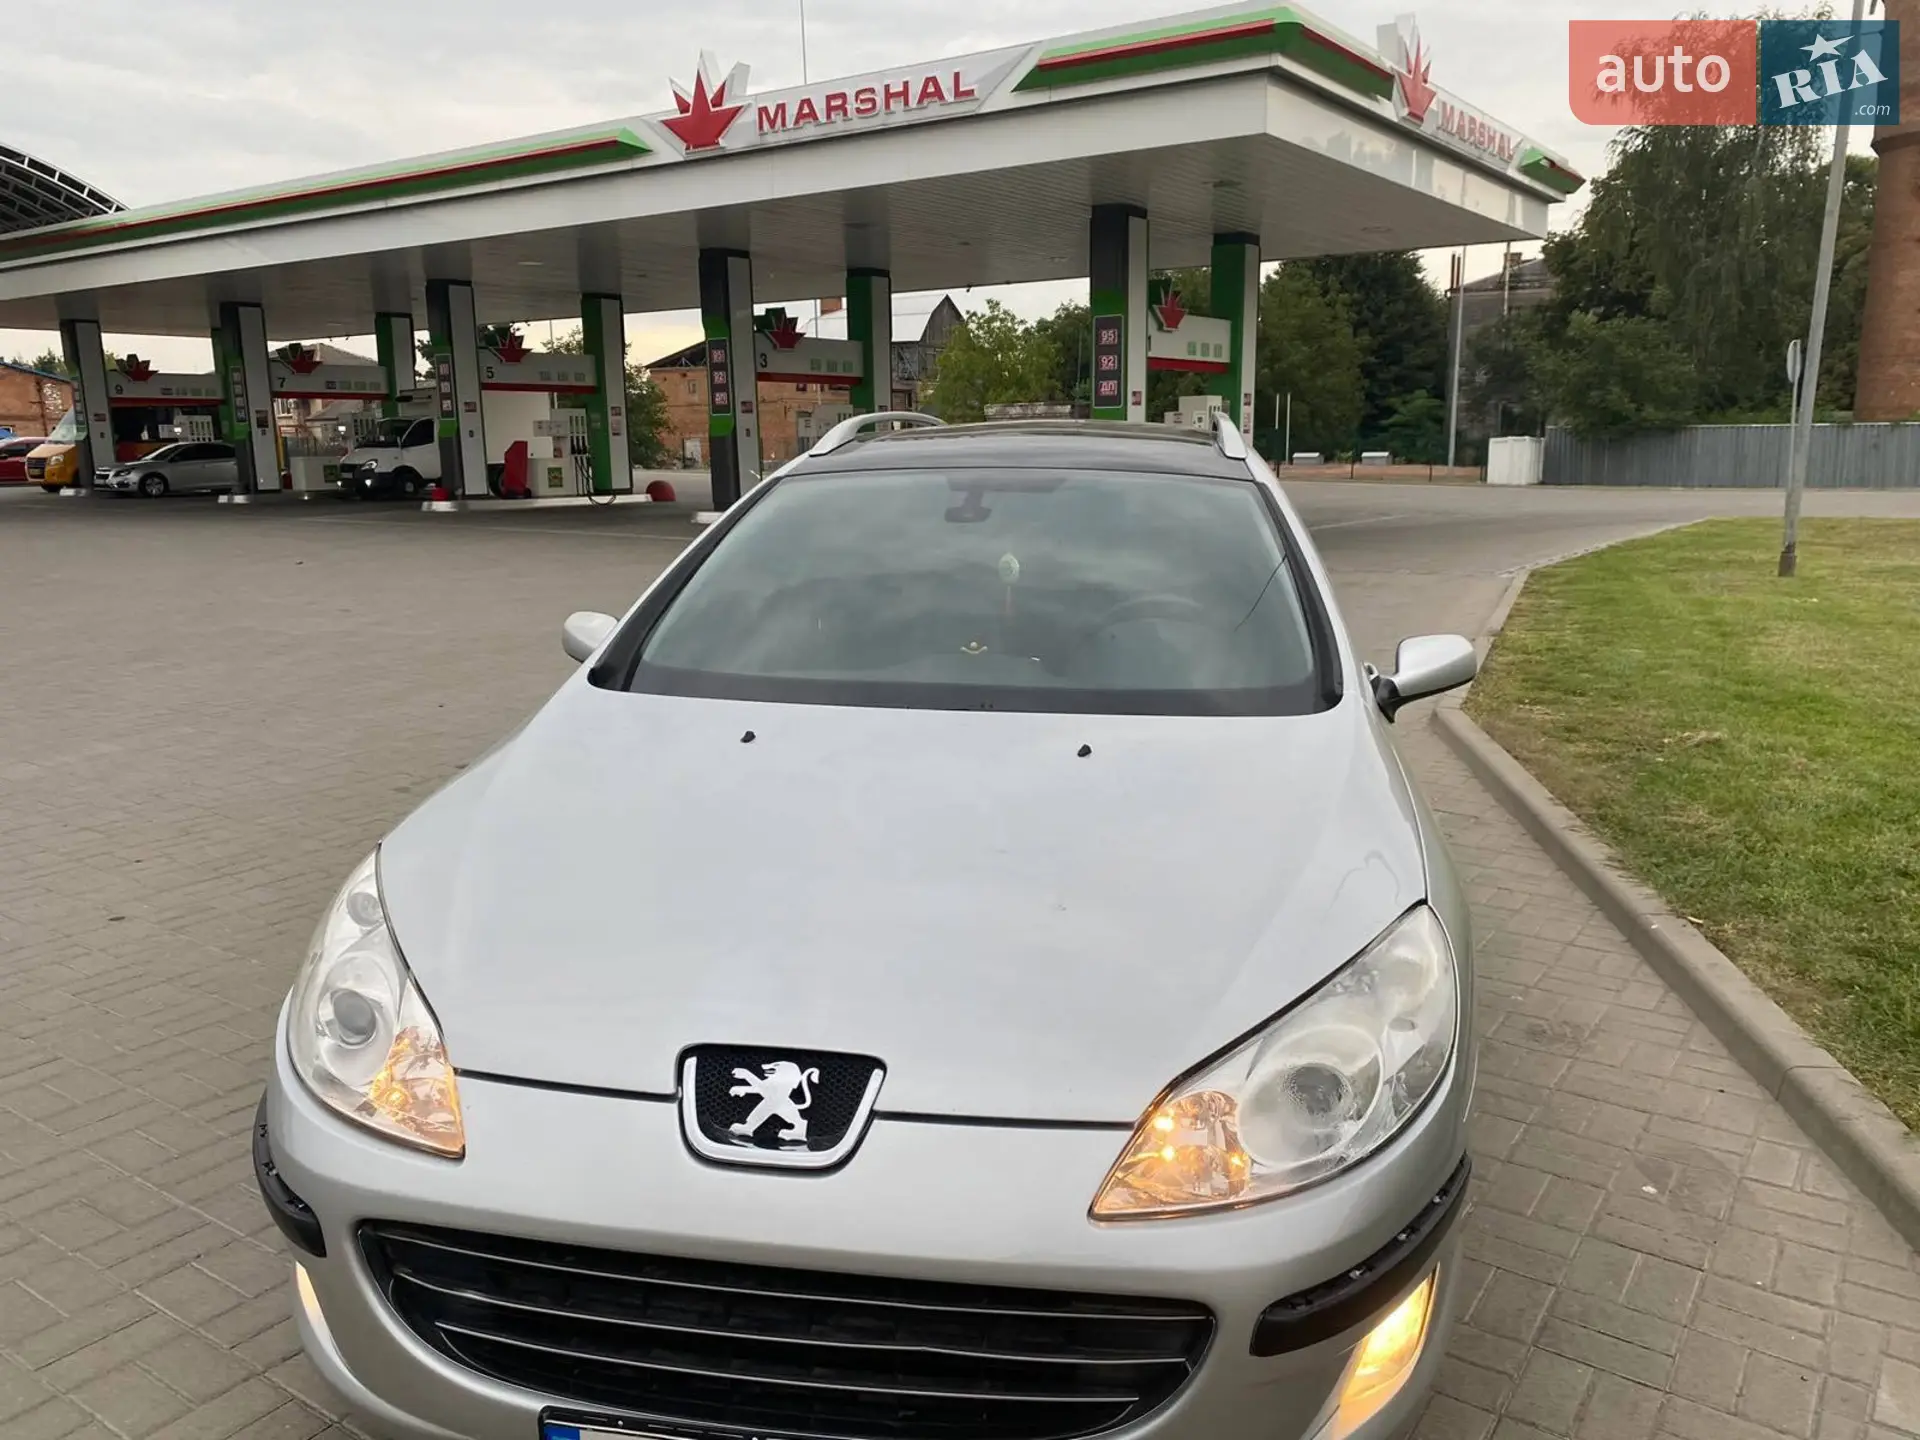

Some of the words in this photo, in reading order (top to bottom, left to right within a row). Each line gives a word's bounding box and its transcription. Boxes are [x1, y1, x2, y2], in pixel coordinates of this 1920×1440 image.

[757, 70, 978, 134] MARSHAL
[1437, 100, 1516, 160] MARSHAL
[1101, 330, 1114, 341] 95
[759, 352, 768, 368] 3
[1101, 356, 1114, 367] 92
[486, 366, 494, 379] 5
[277, 376, 286, 388] 7
[115, 384, 123, 395] 9
